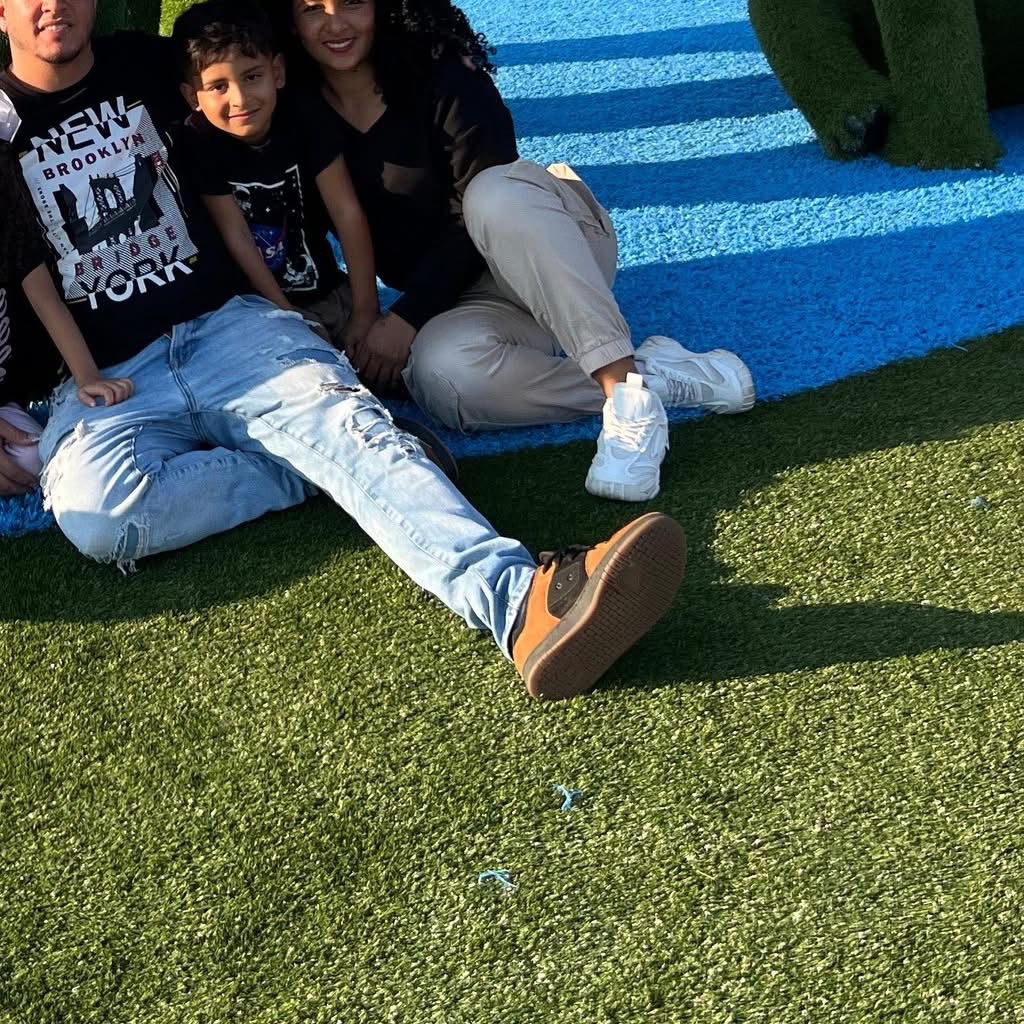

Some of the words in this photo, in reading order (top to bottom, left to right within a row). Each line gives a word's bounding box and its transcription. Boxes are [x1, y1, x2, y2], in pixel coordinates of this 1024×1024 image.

[30, 96, 133, 163] NEW
[43, 133, 145, 181] BROOKLYN
[76, 226, 178, 275] BRIDGE
[80, 247, 194, 310] YORK
